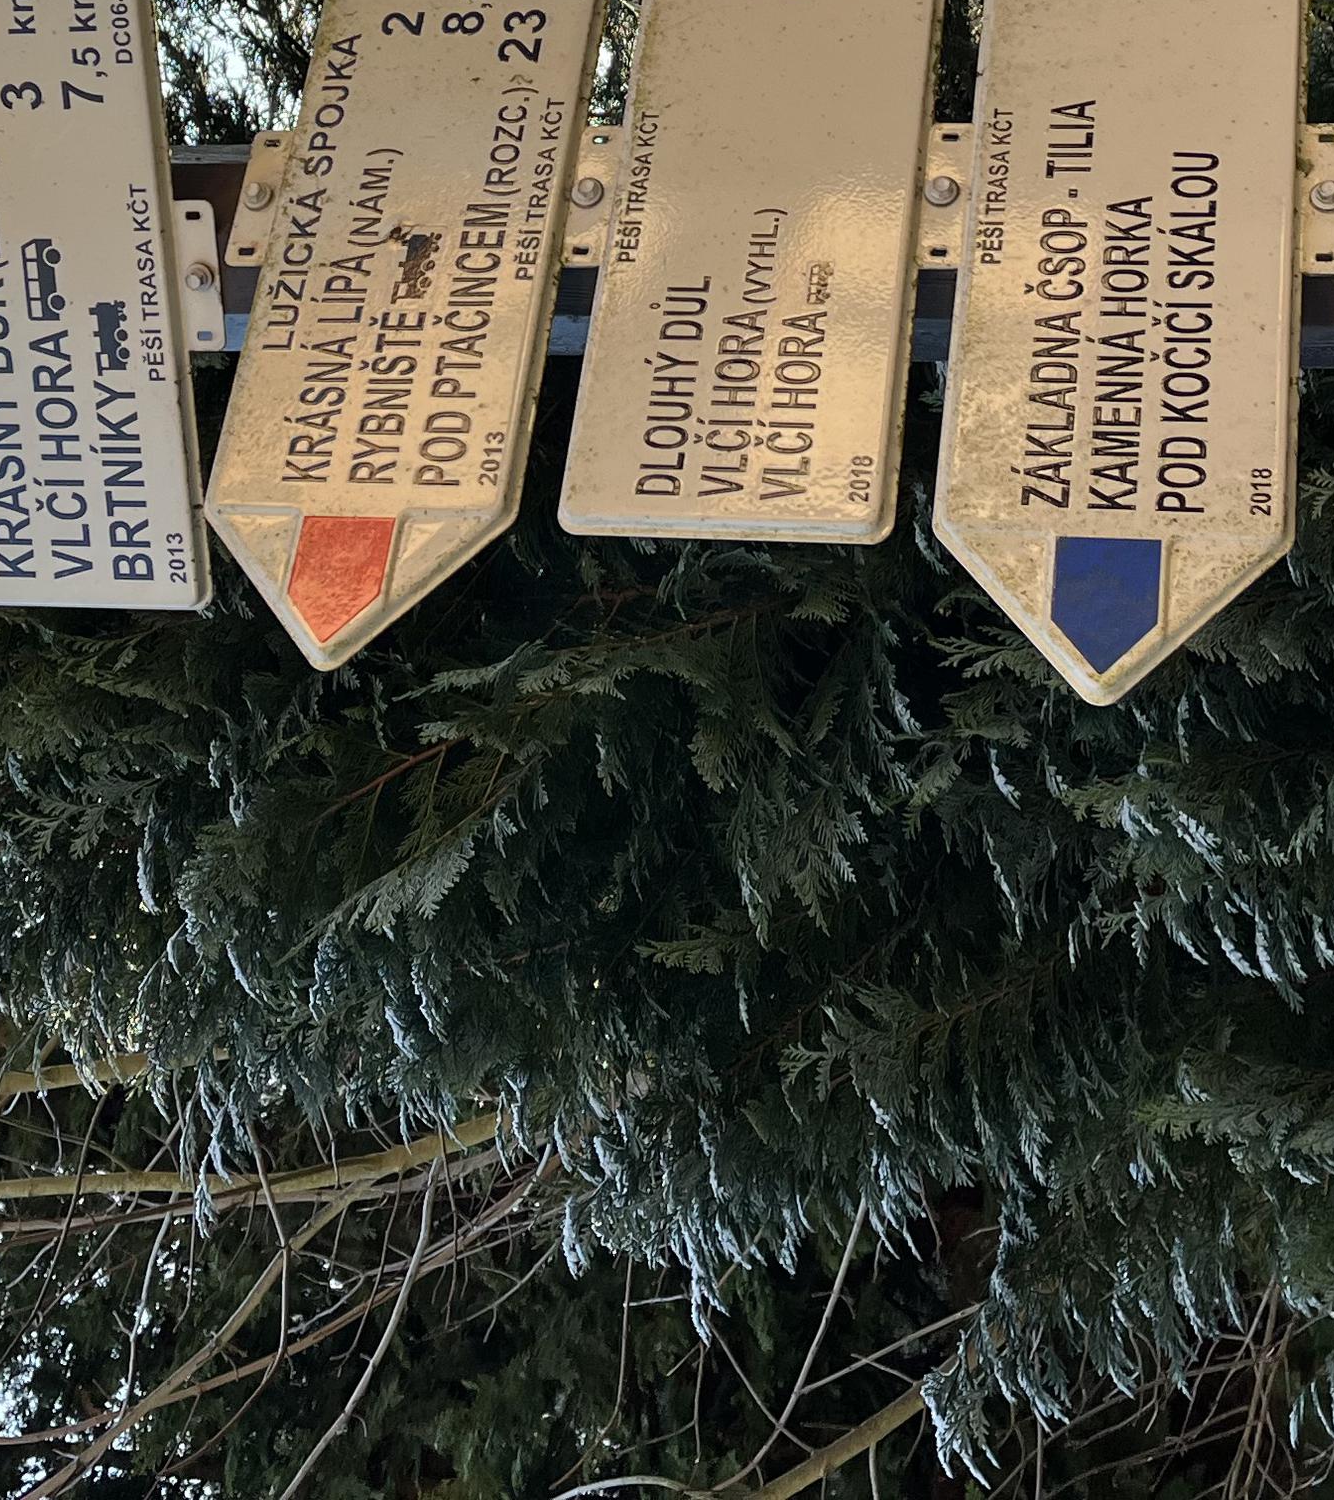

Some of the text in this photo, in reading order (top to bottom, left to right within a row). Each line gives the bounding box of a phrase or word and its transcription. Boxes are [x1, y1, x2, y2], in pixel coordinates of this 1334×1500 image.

[0, 81, 43, 111] 3
[62, 47, 108, 110] 7,5
[382, 12, 426, 36] 2
[497, 8, 547, 63] 23
[262, 33, 362, 351] LUŽICKÁ SPOJKA
[514, 97, 565, 280] PĚŠÍ TRASA KČT
[615, 111, 659, 263] PĚŠÍ TRASA KČT
[978, 108, 1014, 265] PĚŠÍ TRASA KČT
[1045, 99, 1097, 179] TILIA
[127, 183, 166, 382] PĚŠÍ TRASA KČT
[282, 148, 403, 483] KRÁSNÁ LÍPA (NÁM.)
[414, 87, 539, 486] POD PTAČINCEM (ROZC.)
[1024, 208, 1088, 300] ČSOP
[1152, 150, 1220, 513] POD KOČIČÍ SKÁLOU
[348, 310, 428, 484] RYBNIŠTĚ
[635, 275, 711, 496] DLOUHÝ DŮL
[693, 208, 788, 497] VLČÍ HORA (VYHL.)
[754, 311, 828, 500] VLČÍ HORA
[1011, 310, 1083, 508] ZÁKLADNA
[1084, 196, 1154, 511] KAMENNÁ HORKA
[29, 330, 93, 578] VLČÍ HORA
[90, 380, 155, 582] BRTNÍKY
[479, 431, 506, 486] 2013
[849, 455, 874, 502] 2018
[1250, 467, 1273, 516] 2018
[166, 533, 187, 584] 2013
